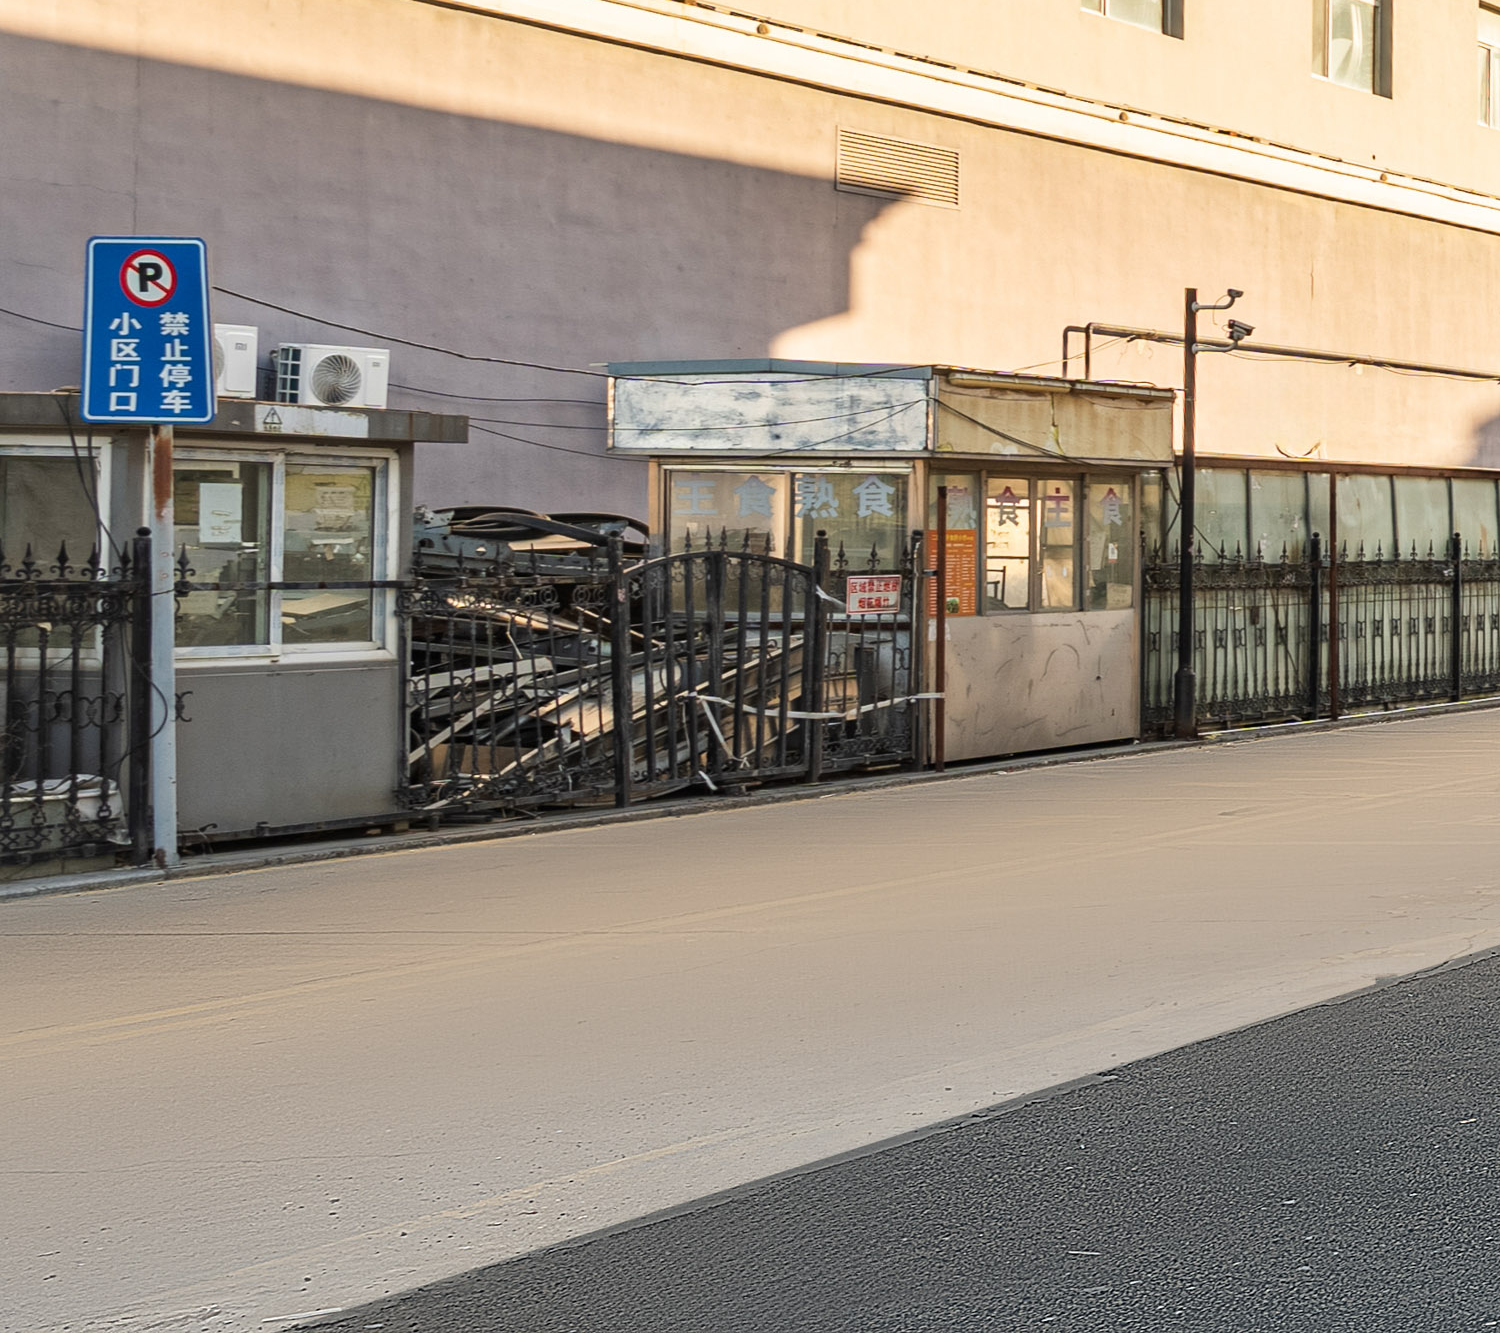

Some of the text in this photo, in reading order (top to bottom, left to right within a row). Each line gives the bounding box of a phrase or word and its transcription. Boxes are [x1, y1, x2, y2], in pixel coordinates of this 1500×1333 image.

[109, 312, 142, 412] 小区门口
[159, 312, 193, 414] 禁止停车
